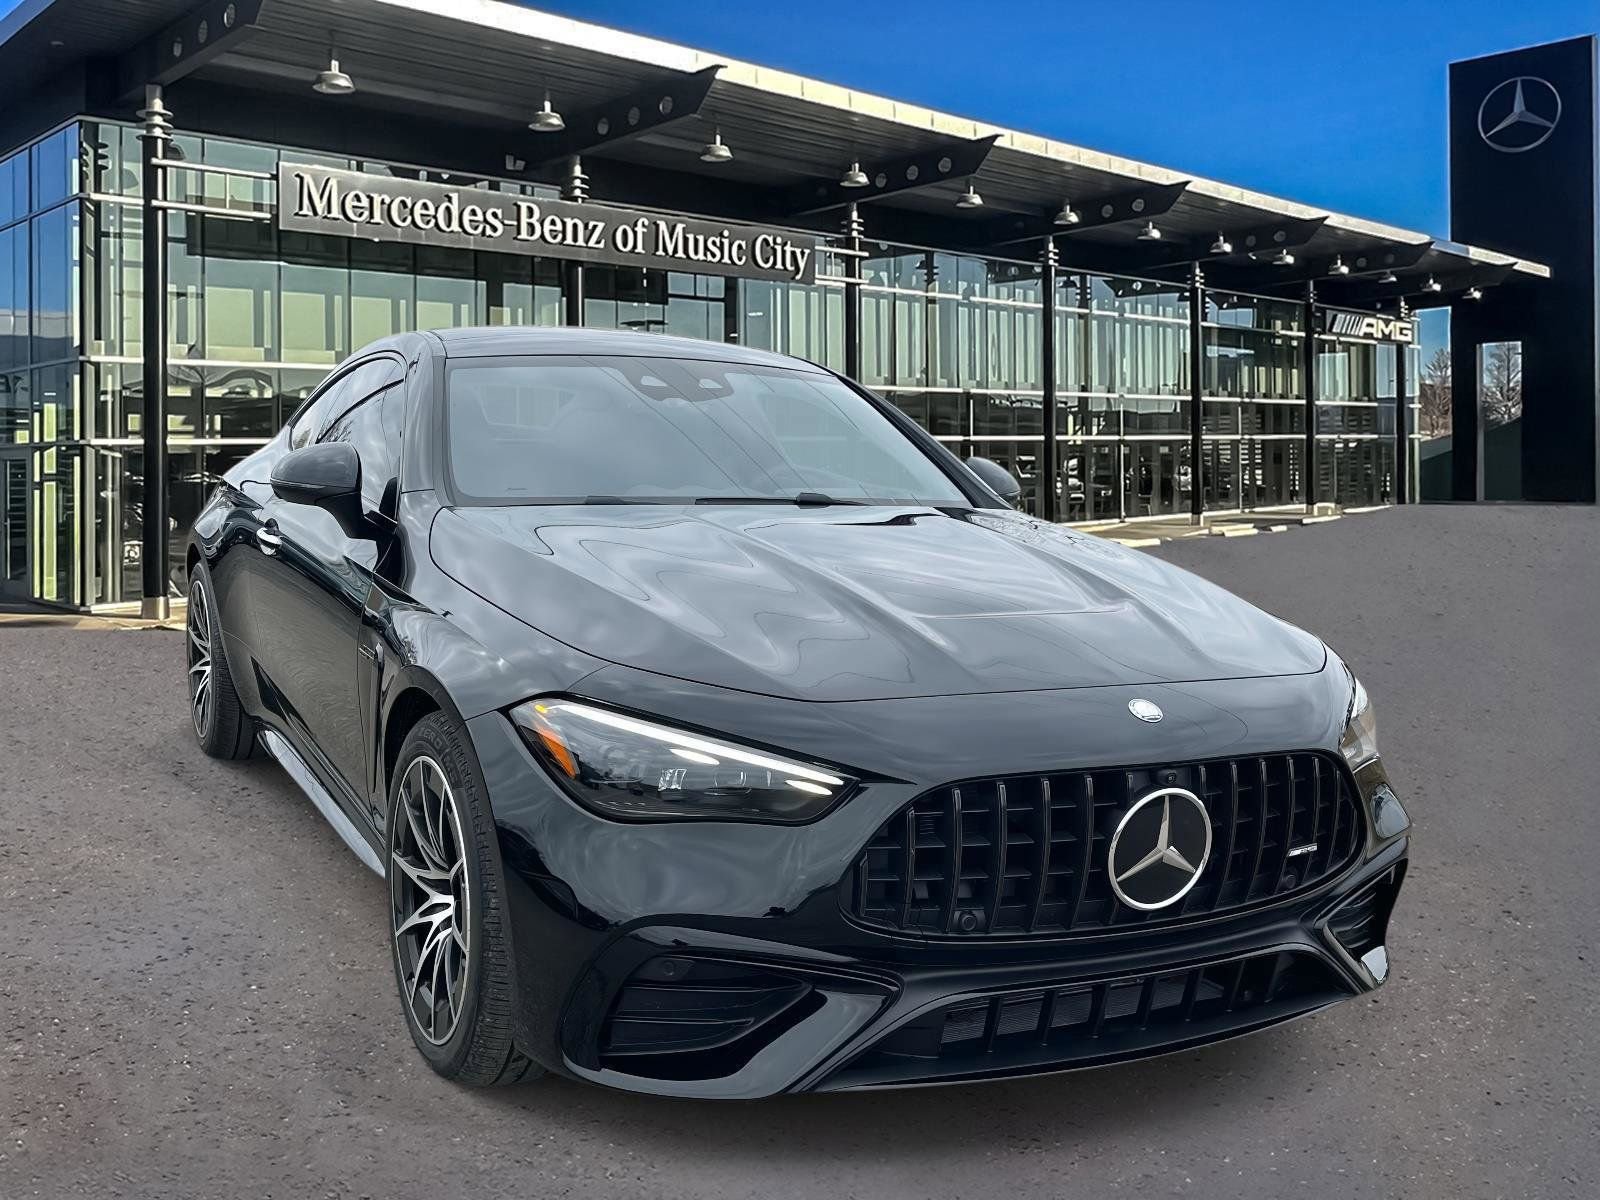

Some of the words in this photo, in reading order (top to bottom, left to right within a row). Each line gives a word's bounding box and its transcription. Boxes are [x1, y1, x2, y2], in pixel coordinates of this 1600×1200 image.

[295, 172, 605, 248] Mercedes-Benz
[615, 217, 649, 254] of
[655, 220, 747, 266] Music
[755, 233, 810, 281] City
[1359, 318, 1412, 342] AMG
